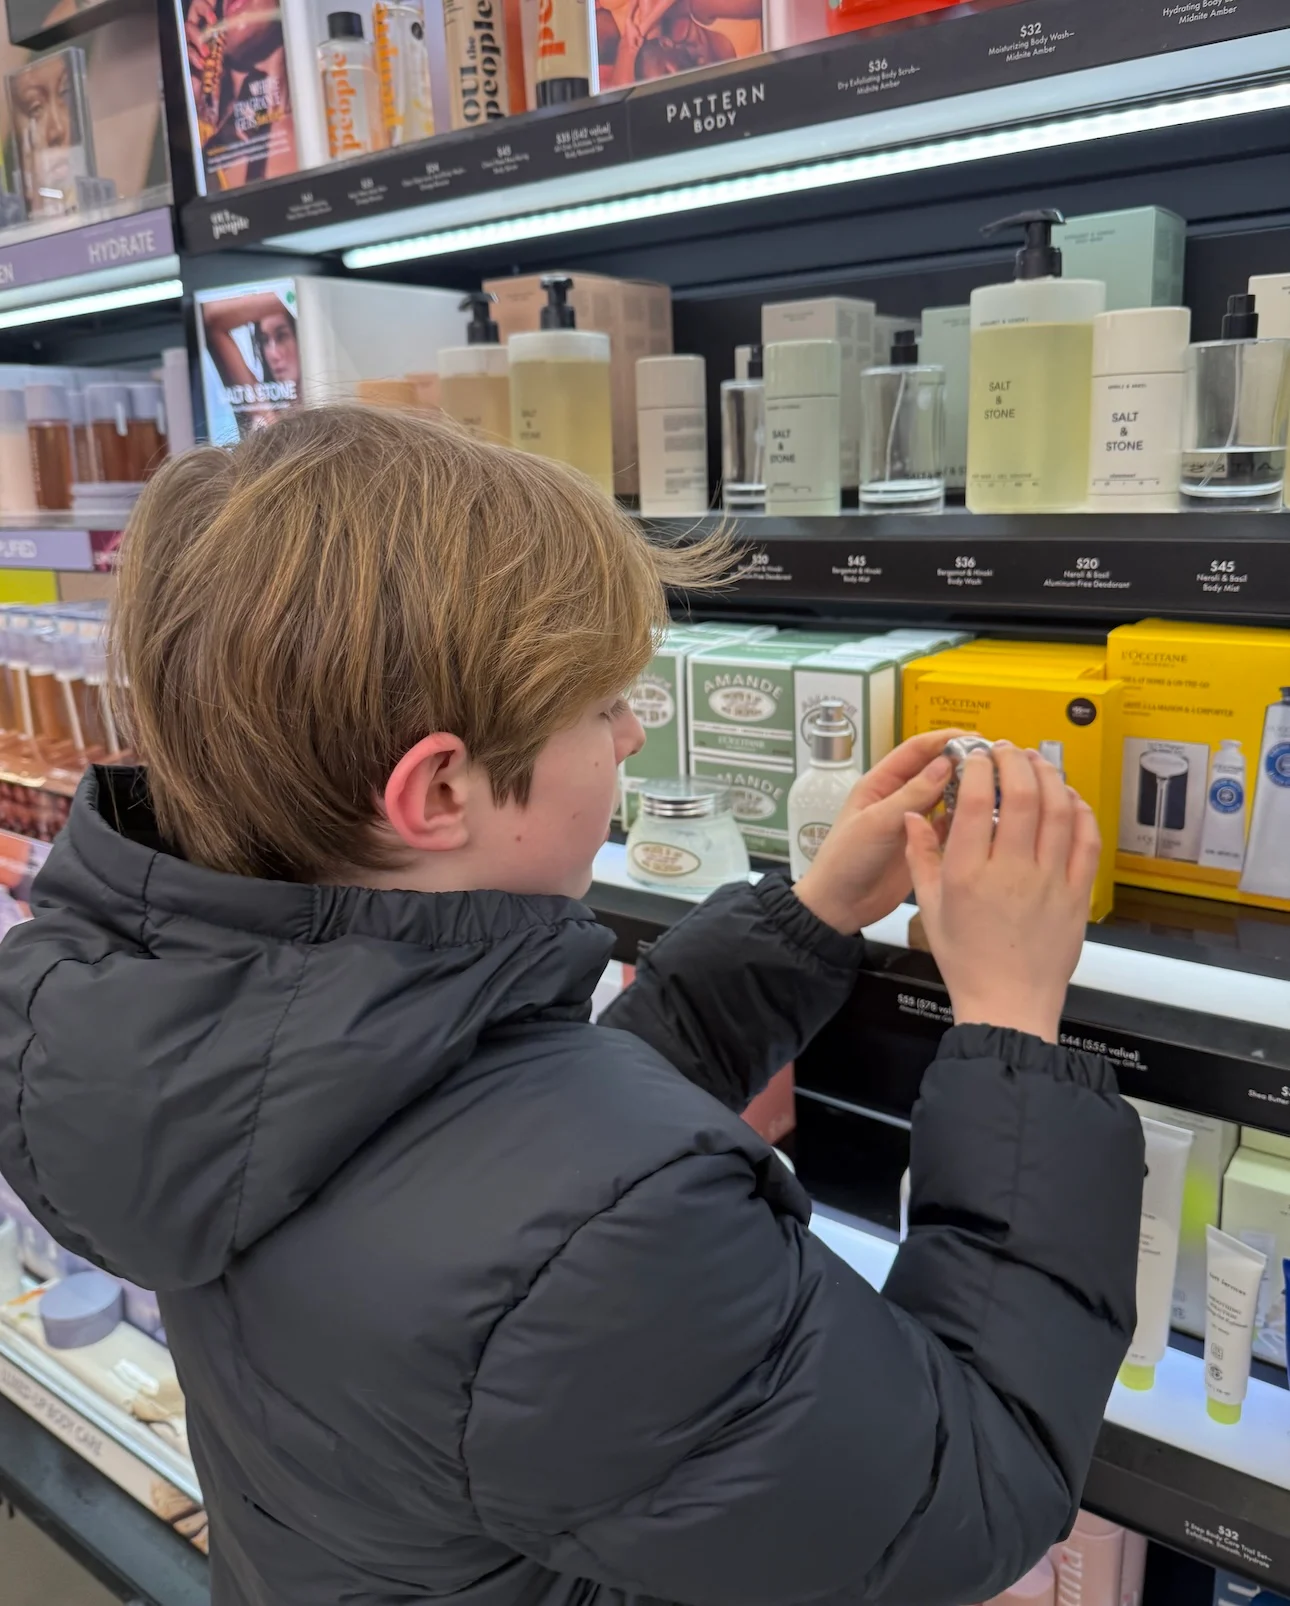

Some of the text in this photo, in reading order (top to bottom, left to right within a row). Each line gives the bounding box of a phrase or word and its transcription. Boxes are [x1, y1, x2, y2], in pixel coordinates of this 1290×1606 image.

[1162, 3, 1201, 17] Hydrating
[1178, 6, 1238, 24] Midnite Amber
[1020, 22, 1042, 38] $32
[988, 39, 1029, 56] Moisturizing
[1030, 35, 1048, 46] Body
[473, 0, 505, 120] people
[1005, 45, 1056, 62] Midnite Amber
[868, 57, 888, 73] $36
[837, 81, 849, 90] Dry
[881, 69, 898, 80] Body
[666, 81, 765, 124] PATTERN
[693, 110, 737, 134] BODY
[87, 230, 157, 265] HYDRATE
[989, 380, 1012, 393] SALT
[995, 395, 1002, 405] &
[984, 408, 1016, 420] STONE
[1112, 411, 1139, 423] SALT
[772, 428, 791, 440] SALT
[1119, 426, 1128, 437] &
[1106, 440, 1144, 452] STONE
[770, 453, 796, 464] STONE
[847, 555, 866, 567] $45
[955, 555, 976, 568] $36
[1076, 557, 1099, 570] $20
[1210, 559, 1235, 572] $45
[1063, 570, 1110, 579] Neroli & Basil
[1196, 573, 1248, 582] Neroli & Basil
[947, 577, 982, 586] Body Wash
[1093, 580, 1131, 589] Deodorant
[1203, 582, 1240, 593] Body Mist
[703, 673, 784, 700] AMANDE
[1060, 1033, 1140, 1062] $44 ($55 value)
[1190, 1523, 1205, 1534] Step
[1206, 1529, 1223, 1542] Body
[1223, 1537, 1241, 1549] Care
[1218, 1525, 1239, 1541] $32
[1243, 1552, 1270, 1569] Hydrate
